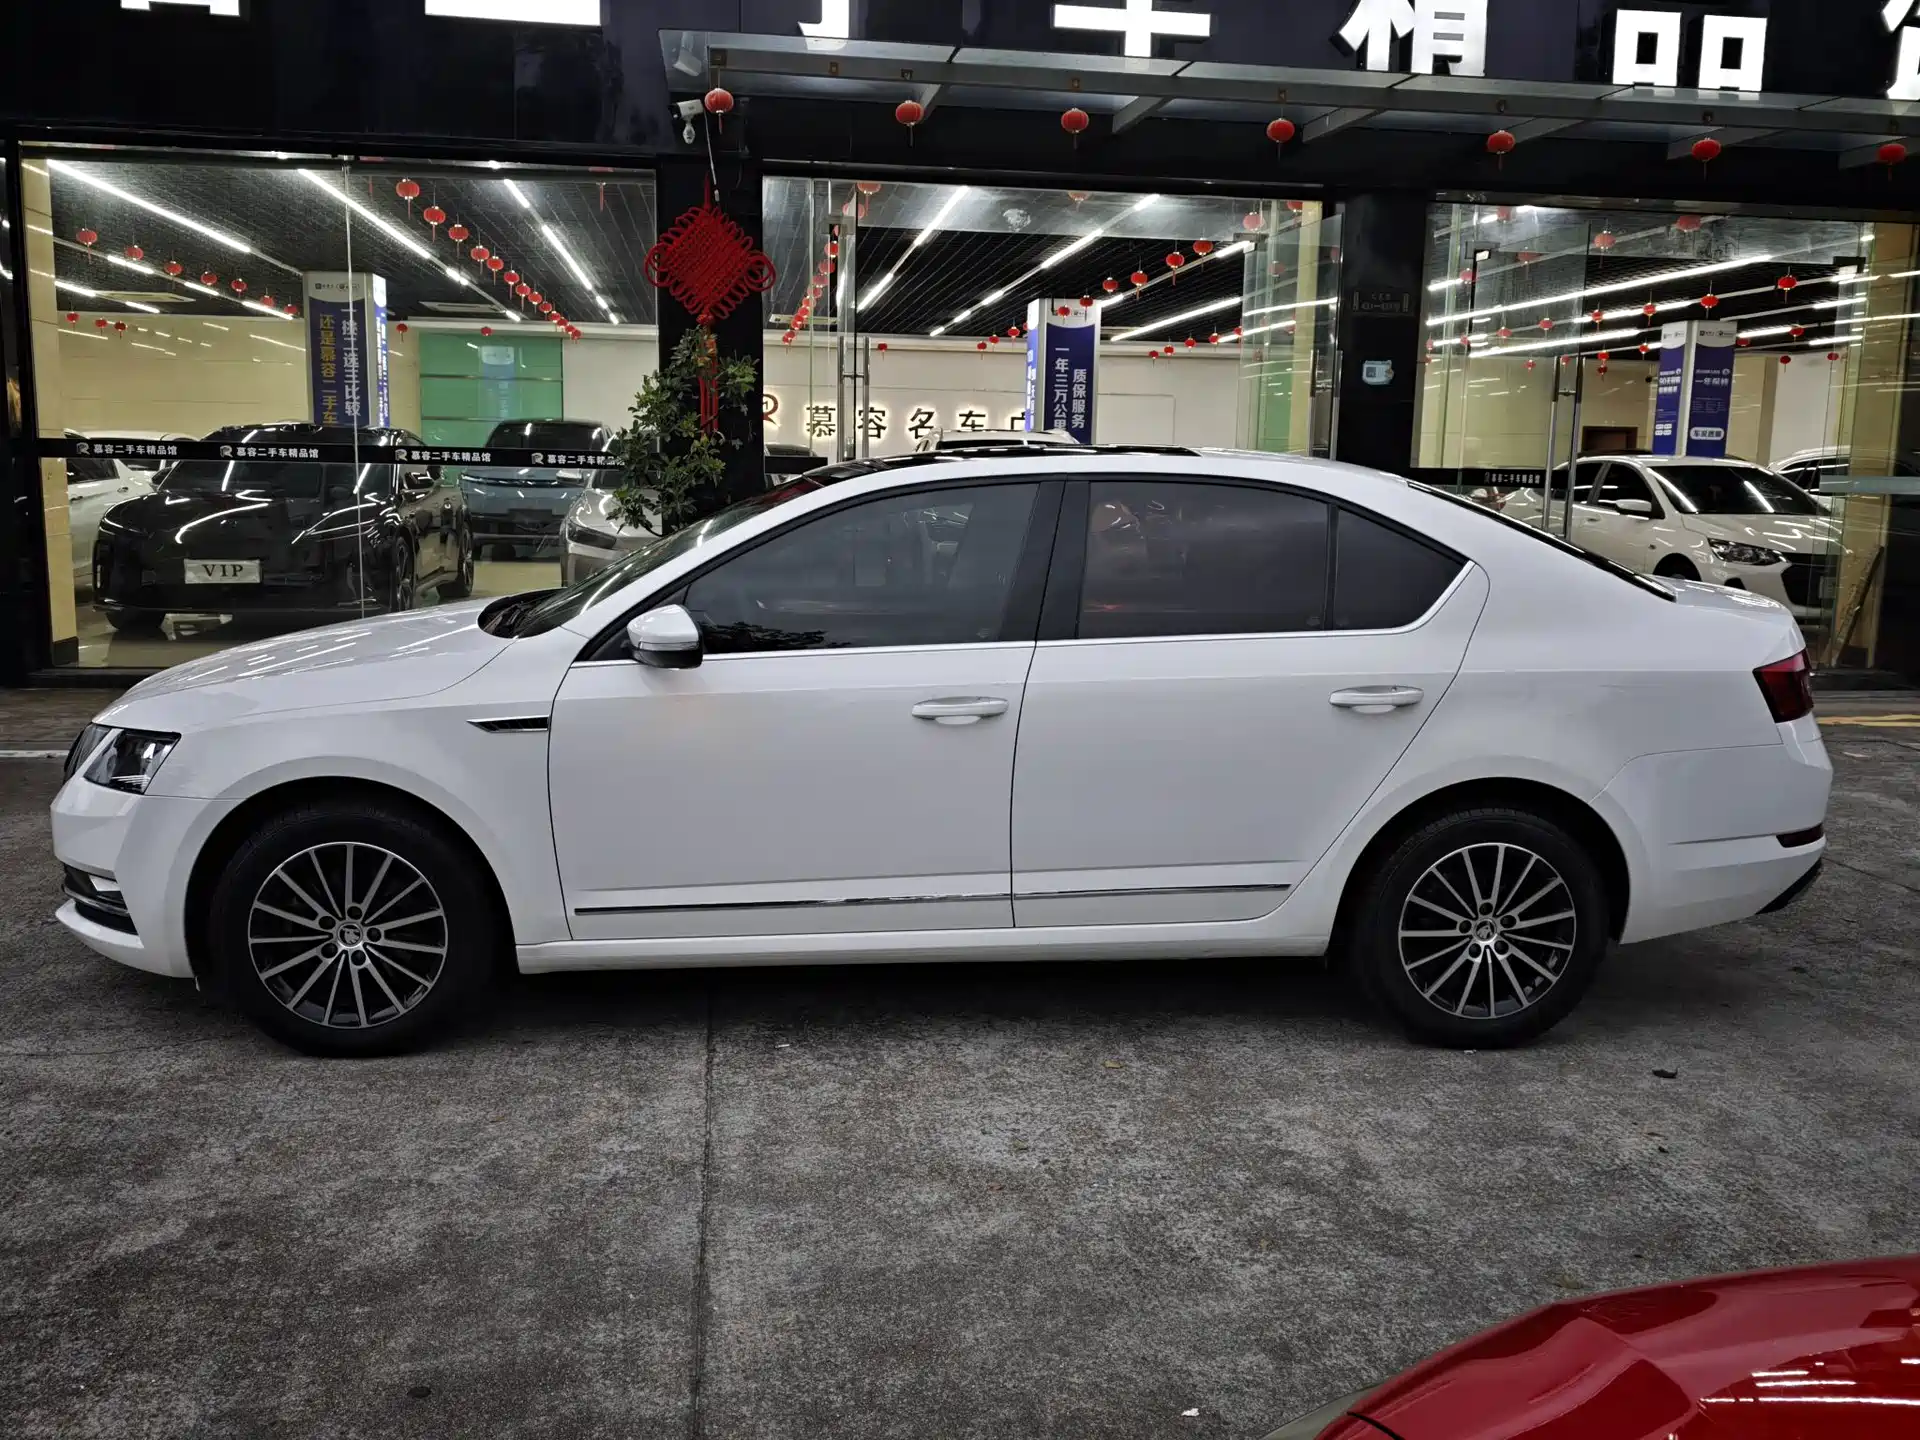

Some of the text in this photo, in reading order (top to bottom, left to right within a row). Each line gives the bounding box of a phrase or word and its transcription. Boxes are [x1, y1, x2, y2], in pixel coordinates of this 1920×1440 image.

[1053, 347, 1070, 430] 一年三万公里
[1072, 368, 1087, 429] 质保服务
[93, 443, 178, 456] 慕容二手车精品馆
[236, 447, 319, 459] 慕容二手车精品馆
[411, 450, 491, 463] 慕容二手车精品馆
[202, 563, 244, 578] VIP
